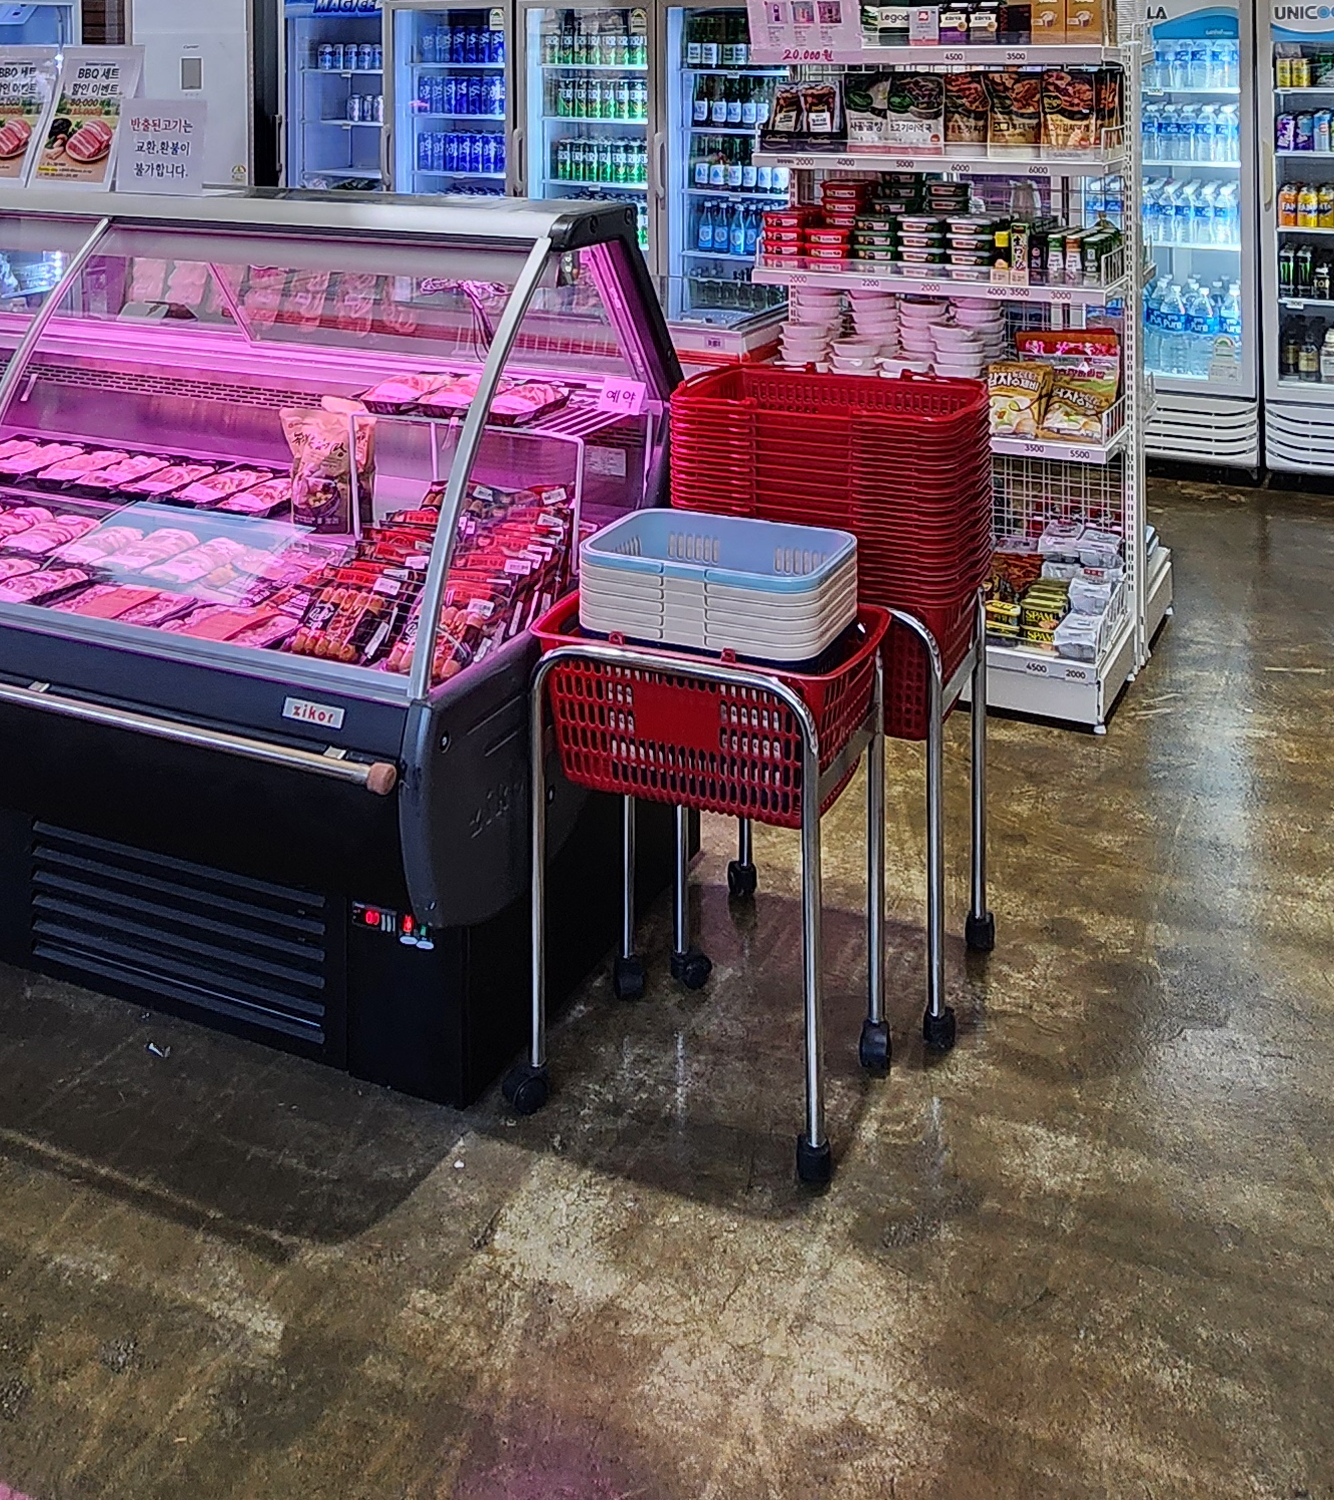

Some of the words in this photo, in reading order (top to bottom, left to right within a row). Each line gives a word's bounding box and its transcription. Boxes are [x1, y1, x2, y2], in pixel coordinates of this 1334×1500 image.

[944, 52, 963, 61] 4500
[1006, 52, 1026, 61] 3500
[78, 68, 100, 79] BBQ
[101, 68, 120, 80] 세트
[71, 83, 90, 96] 할인
[91, 83, 120, 96] 이벤트
[130, 117, 193, 134] 반출된고기는
[135, 140, 191, 157] 교환,환불이
[795, 157, 814, 167] 2000
[836, 158, 855, 167] 4000
[895, 160, 914, 169] 5000
[133, 162, 189, 179] 불가합니다.
[950, 163, 970, 173] 6000
[1028, 166, 1048, 175] 6000
[789, 275, 807, 284] 2000
[861, 279, 880, 287] 2200
[921, 284, 941, 293] 2000
[987, 288, 1007, 297] 4000
[1009, 288, 1030, 297] 3500
[1051, 291, 1072, 300] 3000
[1024, 444, 1045, 453] 3500
[1070, 450, 1090, 459] 5500
[1025, 610, 1054, 621] SPAM
[1027, 630, 1054, 642] SPAM
[1025, 662, 1047, 673] 4500
[1065, 669, 1086, 680] 2000
[292, 703, 335, 725] zikor
